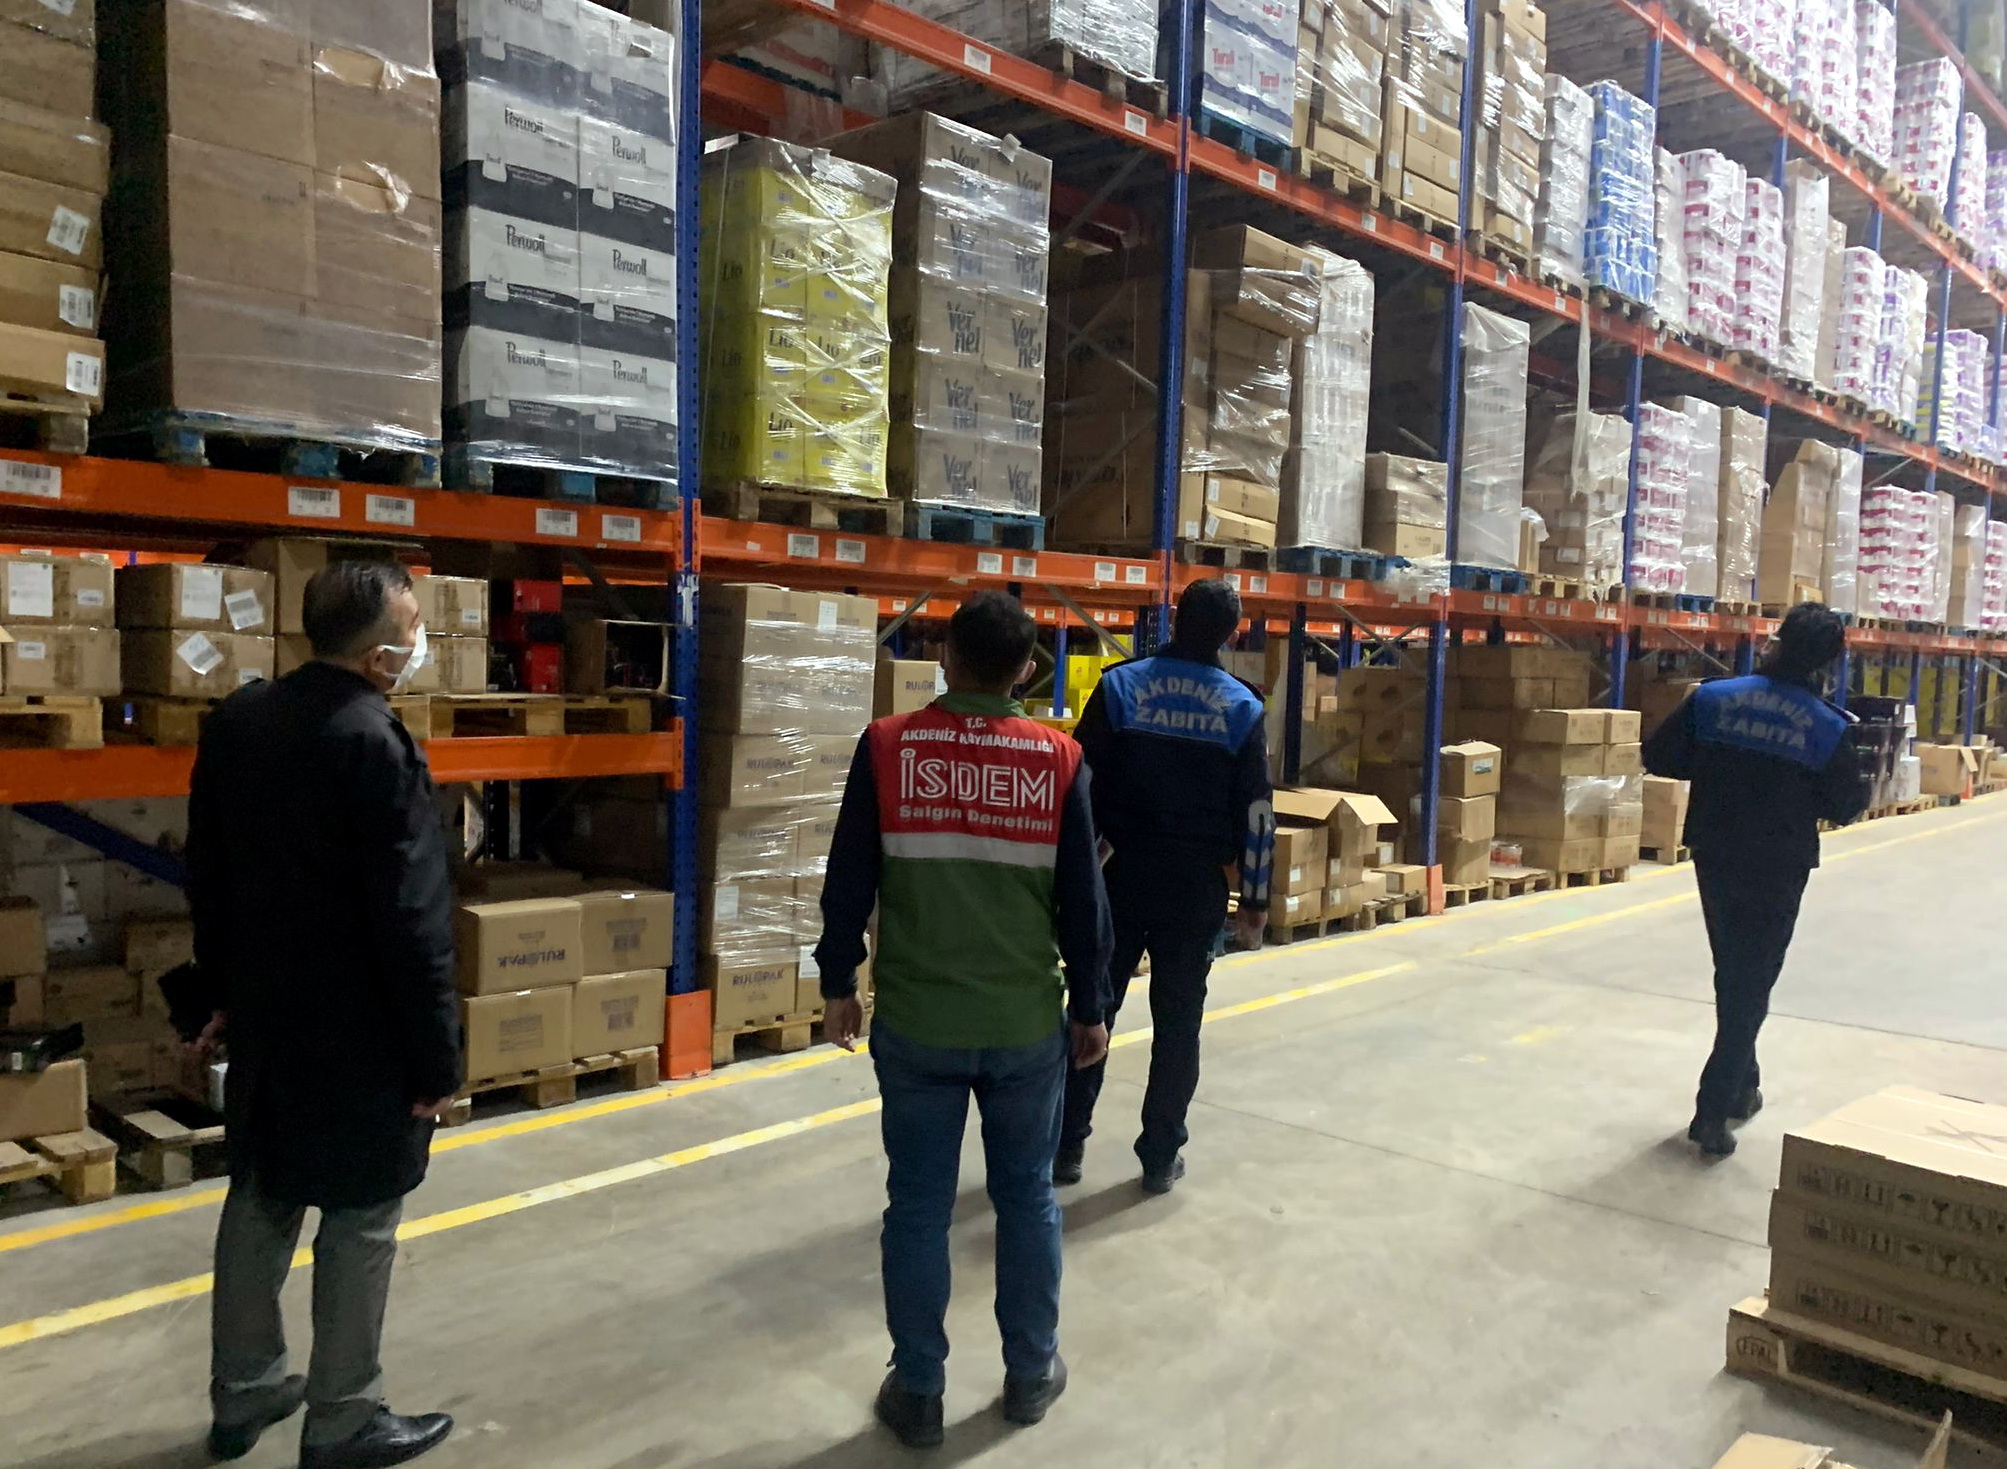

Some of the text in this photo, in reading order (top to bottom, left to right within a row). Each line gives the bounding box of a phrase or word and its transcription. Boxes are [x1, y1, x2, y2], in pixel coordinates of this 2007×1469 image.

[504, 0, 542, 13] erwoll
[612, 136, 647, 165] Perwoll
[505, 225, 545, 252] Perwoll
[612, 249, 648, 276] Perwoll
[947, 300, 976, 332] Ver
[954, 326, 981, 353] nel
[1012, 318, 1038, 346] Ver
[505, 341, 546, 368] Perwoll
[1018, 341, 1042, 368] nel
[612, 359, 648, 385] Perwoll
[945, 378, 975, 408] Ver
[1009, 391, 1036, 419] Ver
[943, 454, 972, 484] Ver
[1007, 463, 1033, 492] Ver
[966, 717, 987, 729] T.C.
[901, 728, 1055, 753] AKDENİZ KAYMAKAMLIĞI
[899, 748, 1055, 811] İSDEM
[900, 804, 1053, 832] Salgın Denetimi
